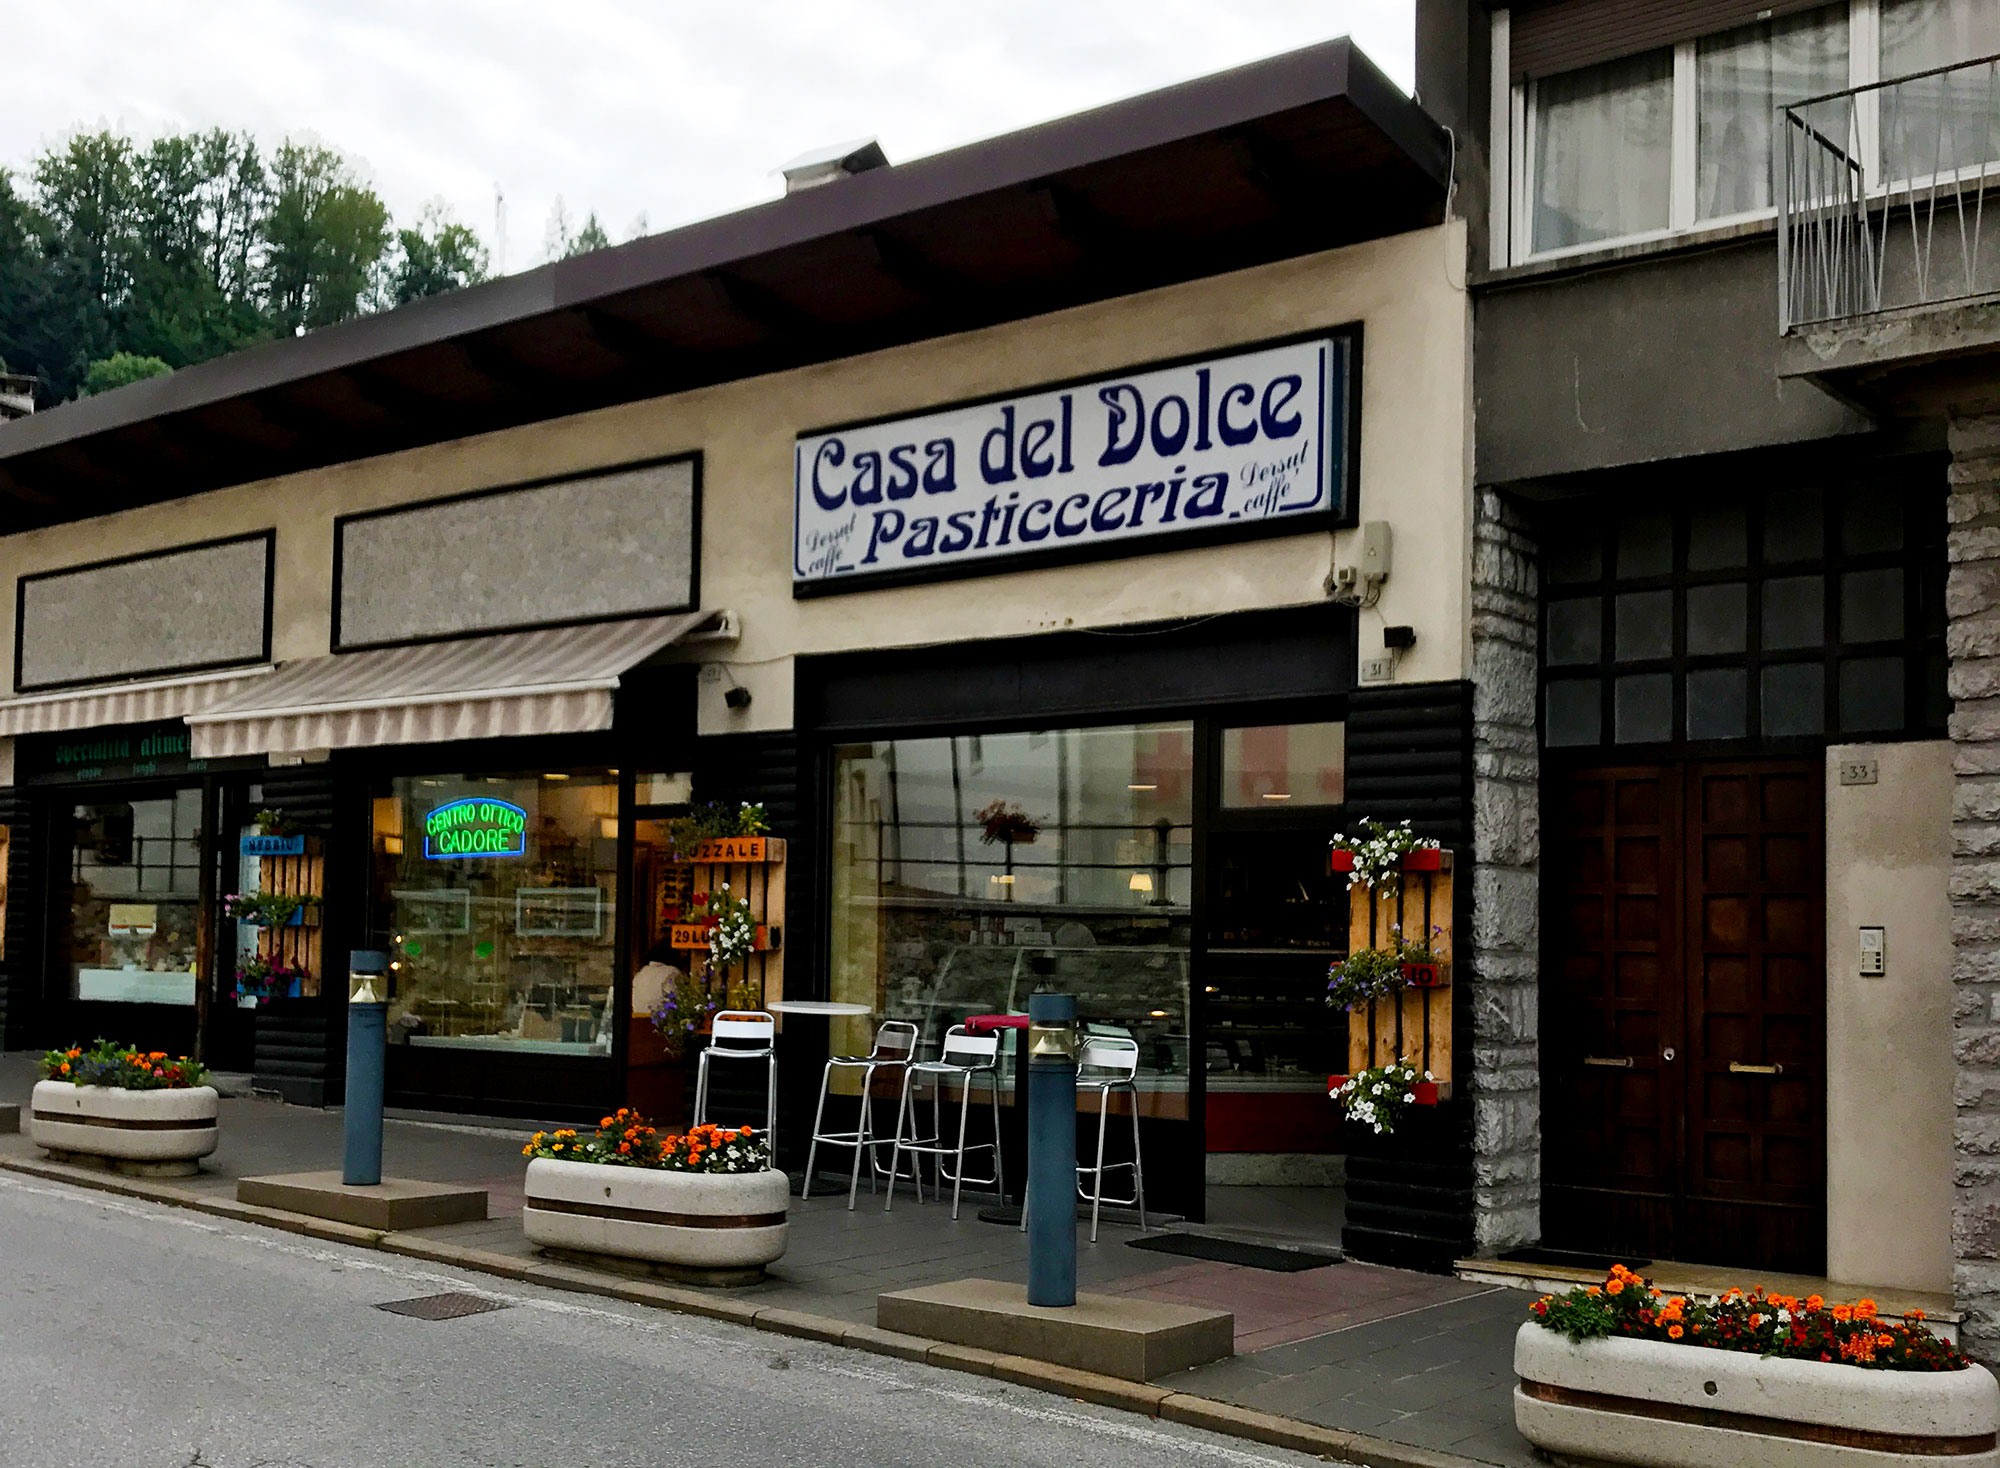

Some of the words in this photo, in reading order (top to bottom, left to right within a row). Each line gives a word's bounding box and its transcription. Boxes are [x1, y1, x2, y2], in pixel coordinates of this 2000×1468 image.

[812, 435, 957, 511] Casa
[980, 394, 1074, 484] del
[1099, 369, 1302, 466] Dolce
[861, 464, 1229, 564] Pasticceria
[1370, 663, 1382, 676] 31
[1850, 764, 1868, 779] 33
[427, 803, 476, 836] CENTRO
[480, 803, 525, 835] OTTICO
[439, 828, 511, 853] CADORE
[675, 930, 689, 943] 29
